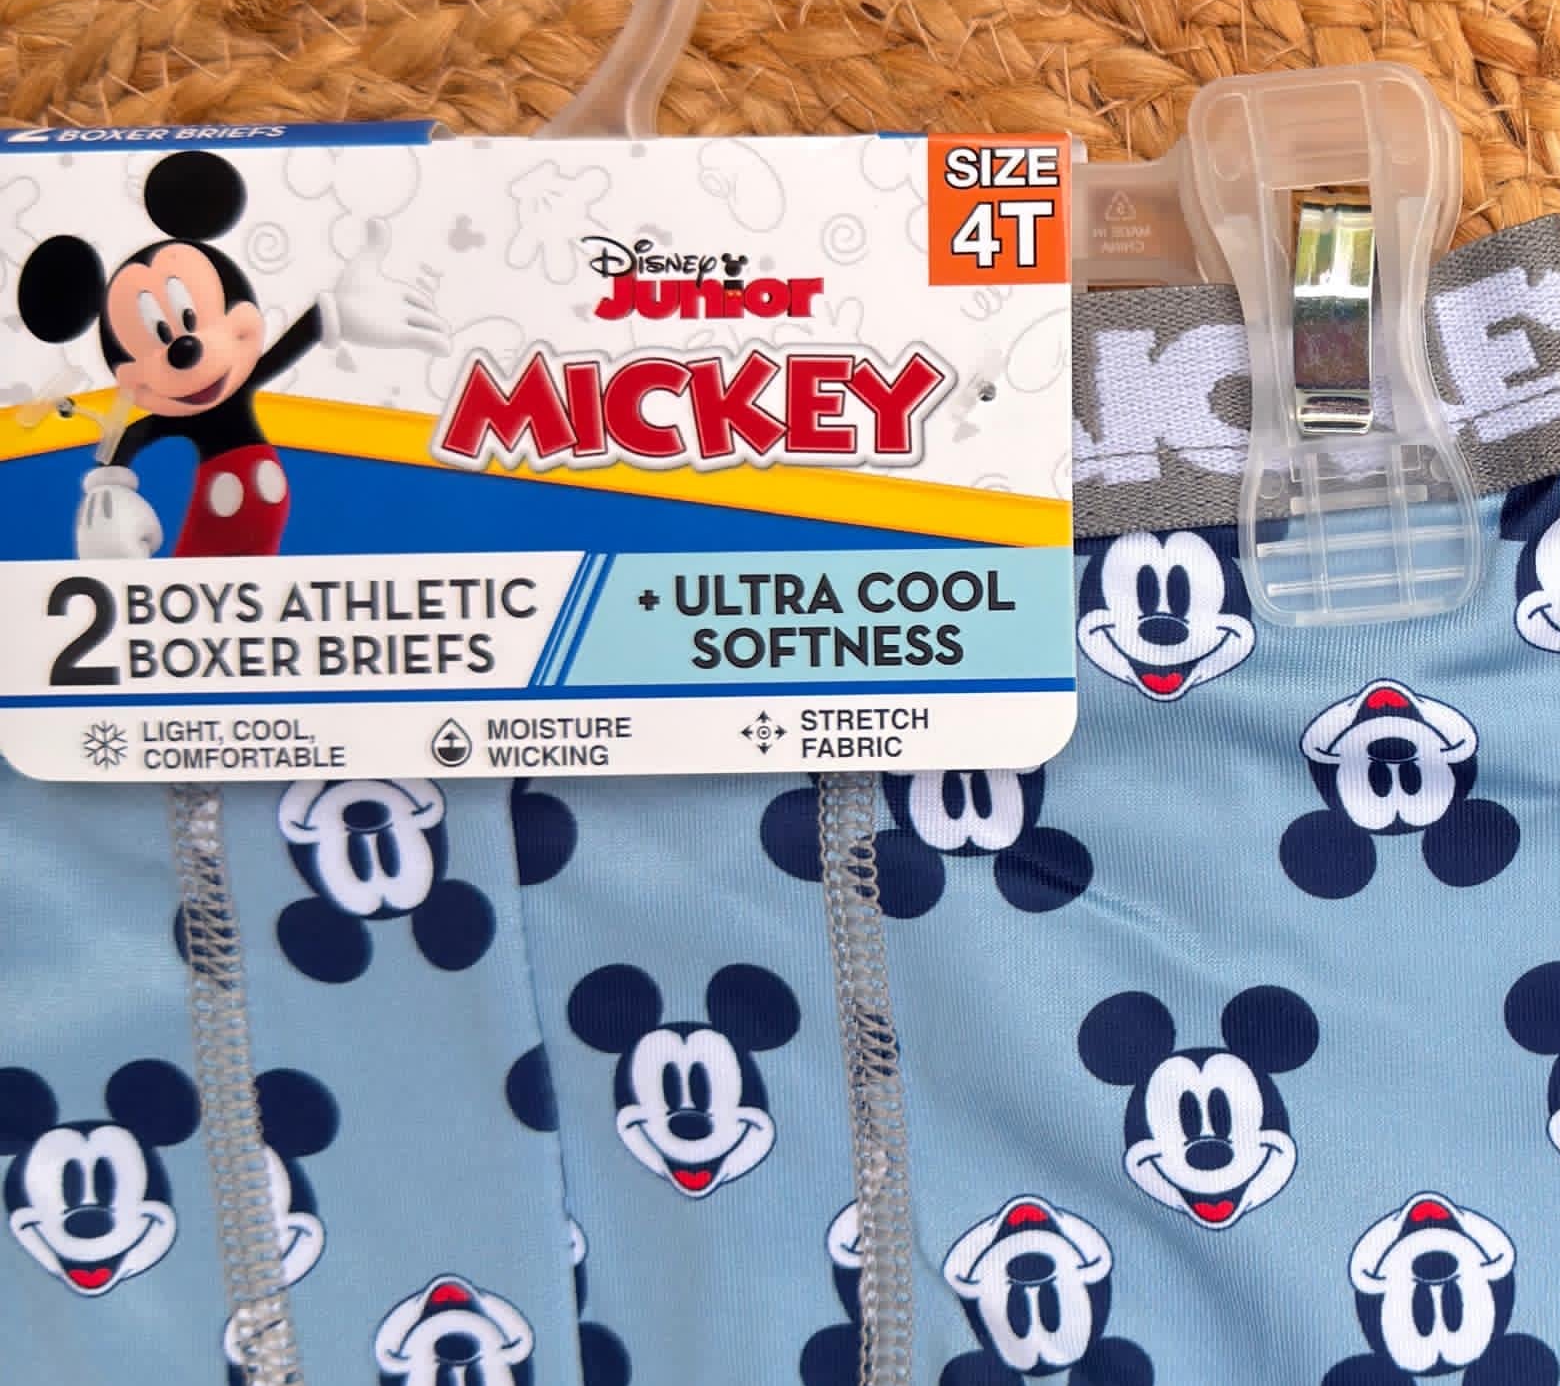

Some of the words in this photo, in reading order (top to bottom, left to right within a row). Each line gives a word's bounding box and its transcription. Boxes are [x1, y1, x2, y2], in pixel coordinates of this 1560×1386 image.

[56, 127, 168, 142] BOXER
[175, 125, 289, 140] BRIEFS
[944, 146, 1060, 188] SIZE
[951, 200, 1054, 270] 4T
[581, 236, 718, 288] Disney
[441, 350, 945, 459] MICKEY
[127, 582, 264, 625] BOYS
[279, 576, 539, 622] ATHLETIC
[674, 573, 843, 617] ULTRA
[856, 569, 1016, 613] COOL
[46, 576, 120, 687] 2
[691, 625, 965, 670] SOFTNESS
[128, 636, 300, 678] BOXER
[318, 633, 495, 677] BRIEFS
[143, 719, 224, 744] LIGHT,
[232, 718, 316, 744] COOL,
[487, 716, 633, 740] MOISTURE
[801, 708, 929, 731] STRETCH
[143, 746, 346, 770] COMFORTABLE
[487, 744, 609, 767] WICKING
[801, 735, 903, 759] FABRIC
